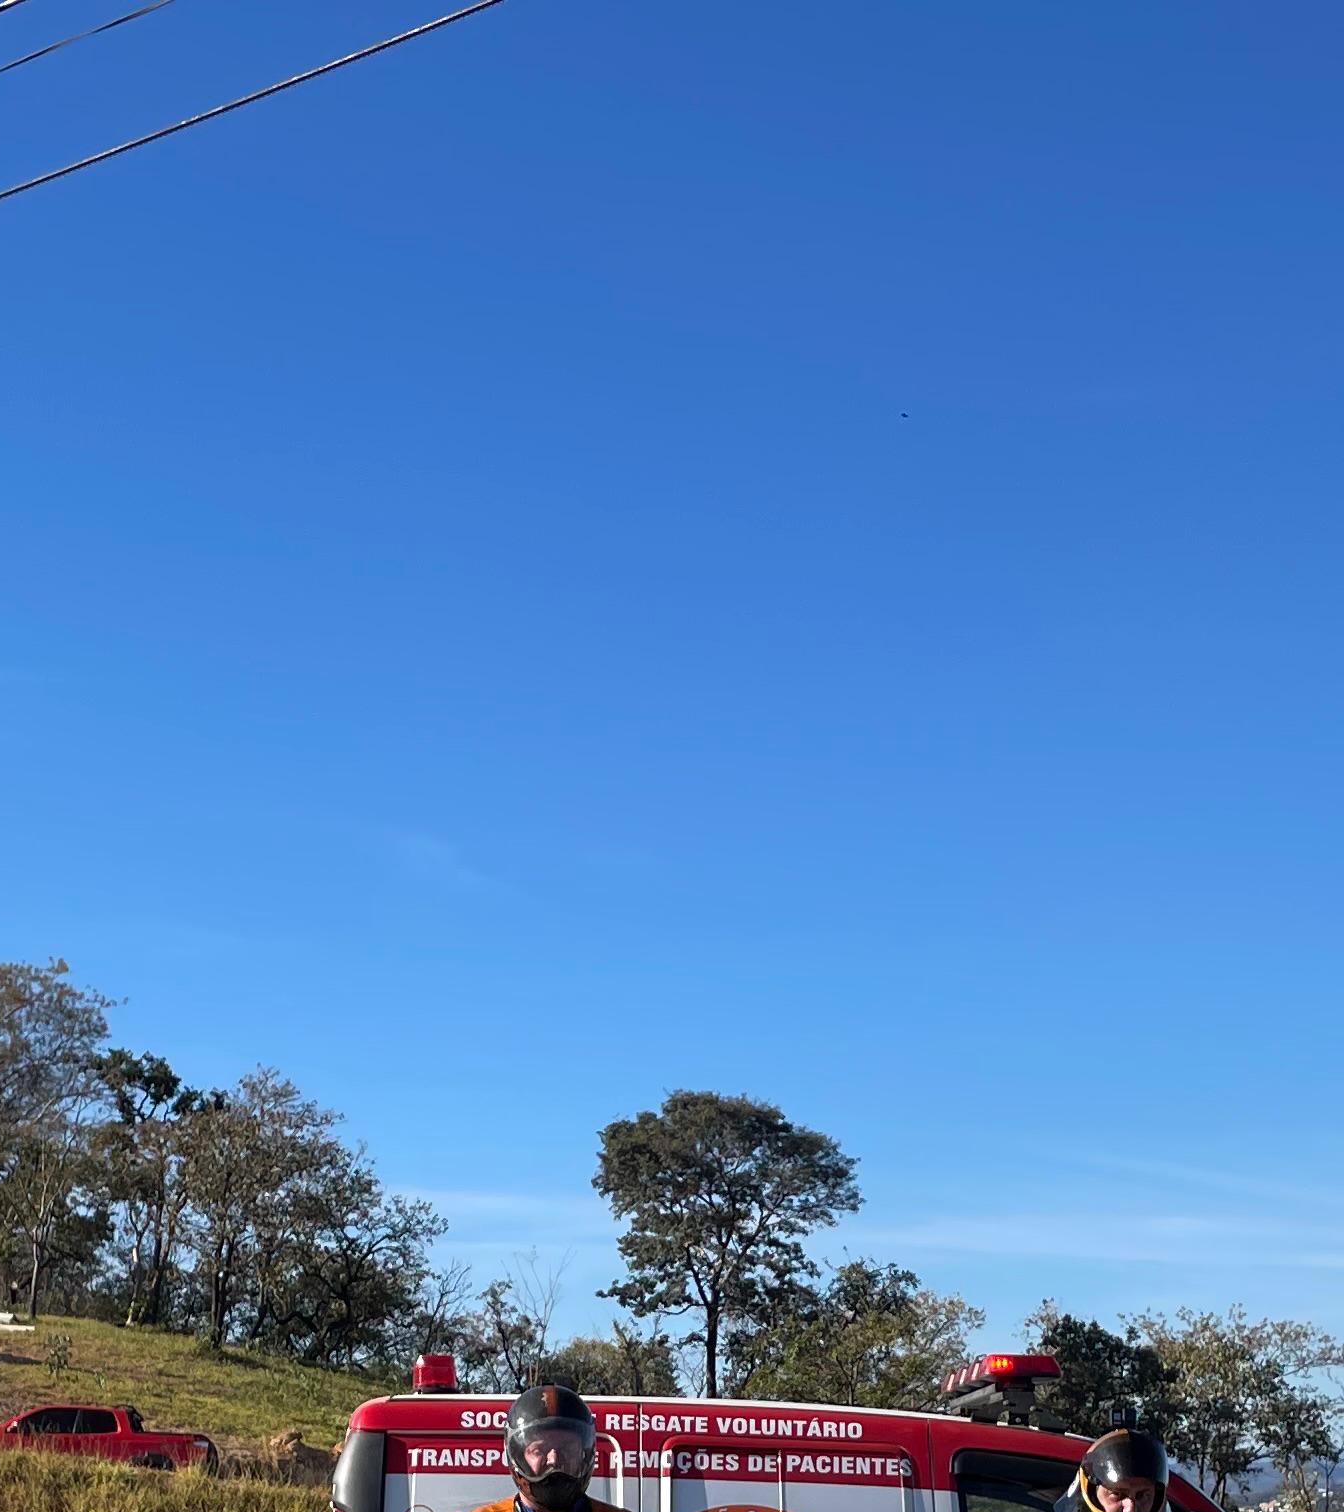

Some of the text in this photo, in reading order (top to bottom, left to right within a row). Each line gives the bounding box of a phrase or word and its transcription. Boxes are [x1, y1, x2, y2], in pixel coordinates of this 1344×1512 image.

[460, 1411, 863, 1439] SOC RESGATE VOLUNTÁRIO
[609, 1448, 739, 1474] REMOÇÕES
[747, 1454, 777, 1473] DE
[786, 1454, 913, 1477] PACIENTES
